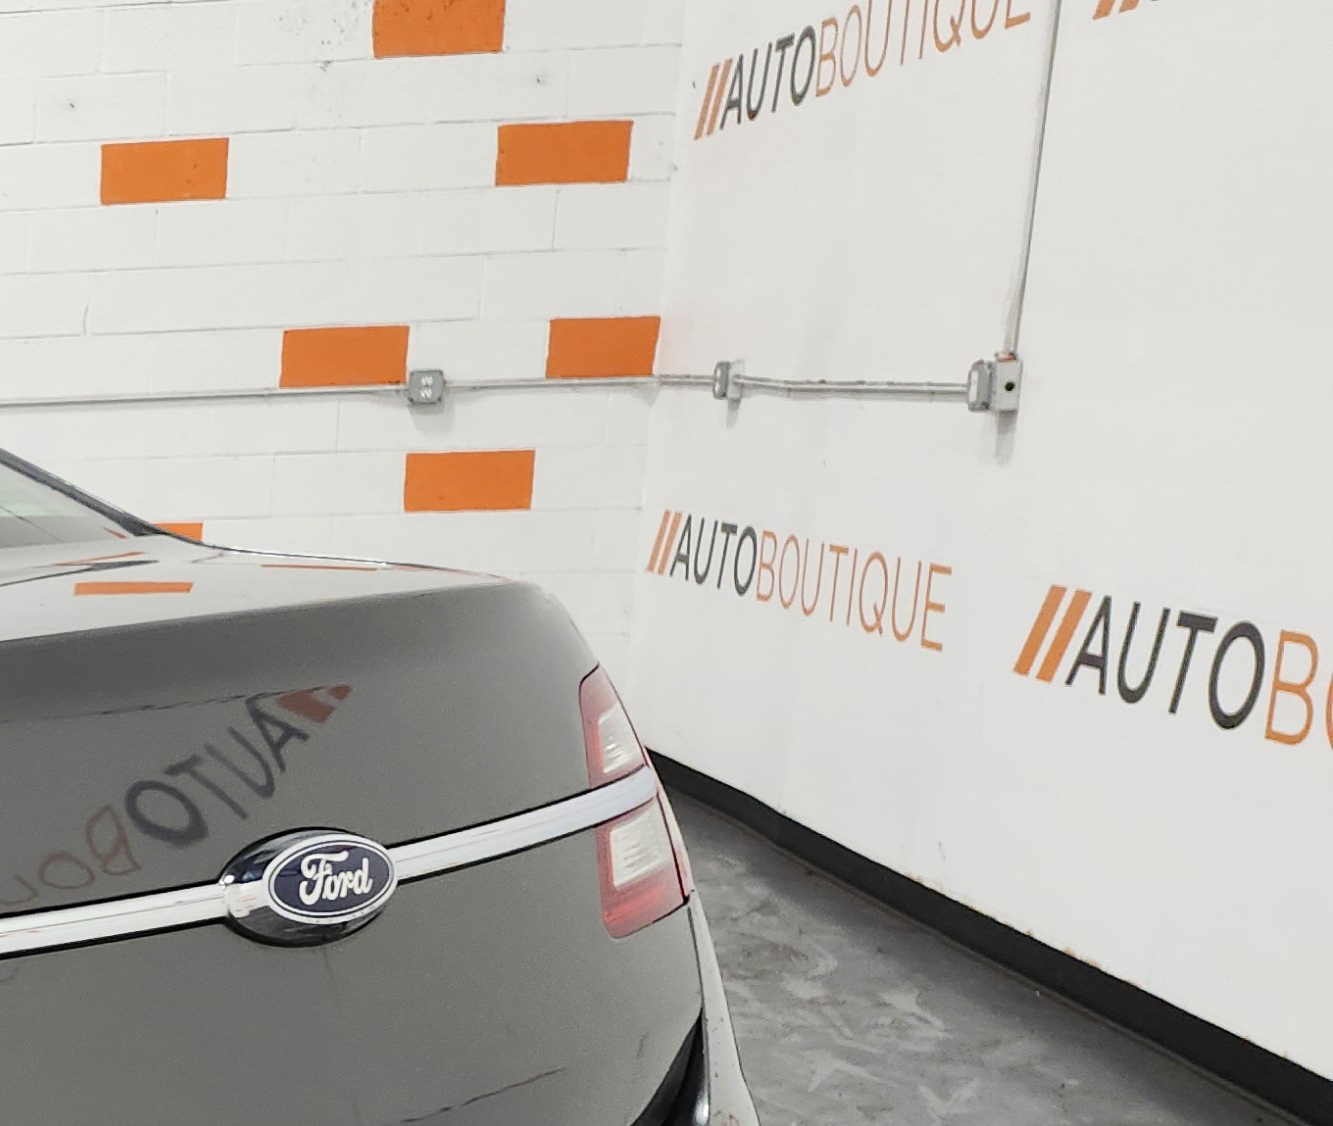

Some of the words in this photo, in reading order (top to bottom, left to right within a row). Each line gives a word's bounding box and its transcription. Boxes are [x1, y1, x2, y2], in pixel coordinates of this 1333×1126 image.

[670, 514, 952, 652] AUTOBOUTIQUE
[1065, 595, 1333, 750] AUTOB
[299, 851, 373, 905] Ford
